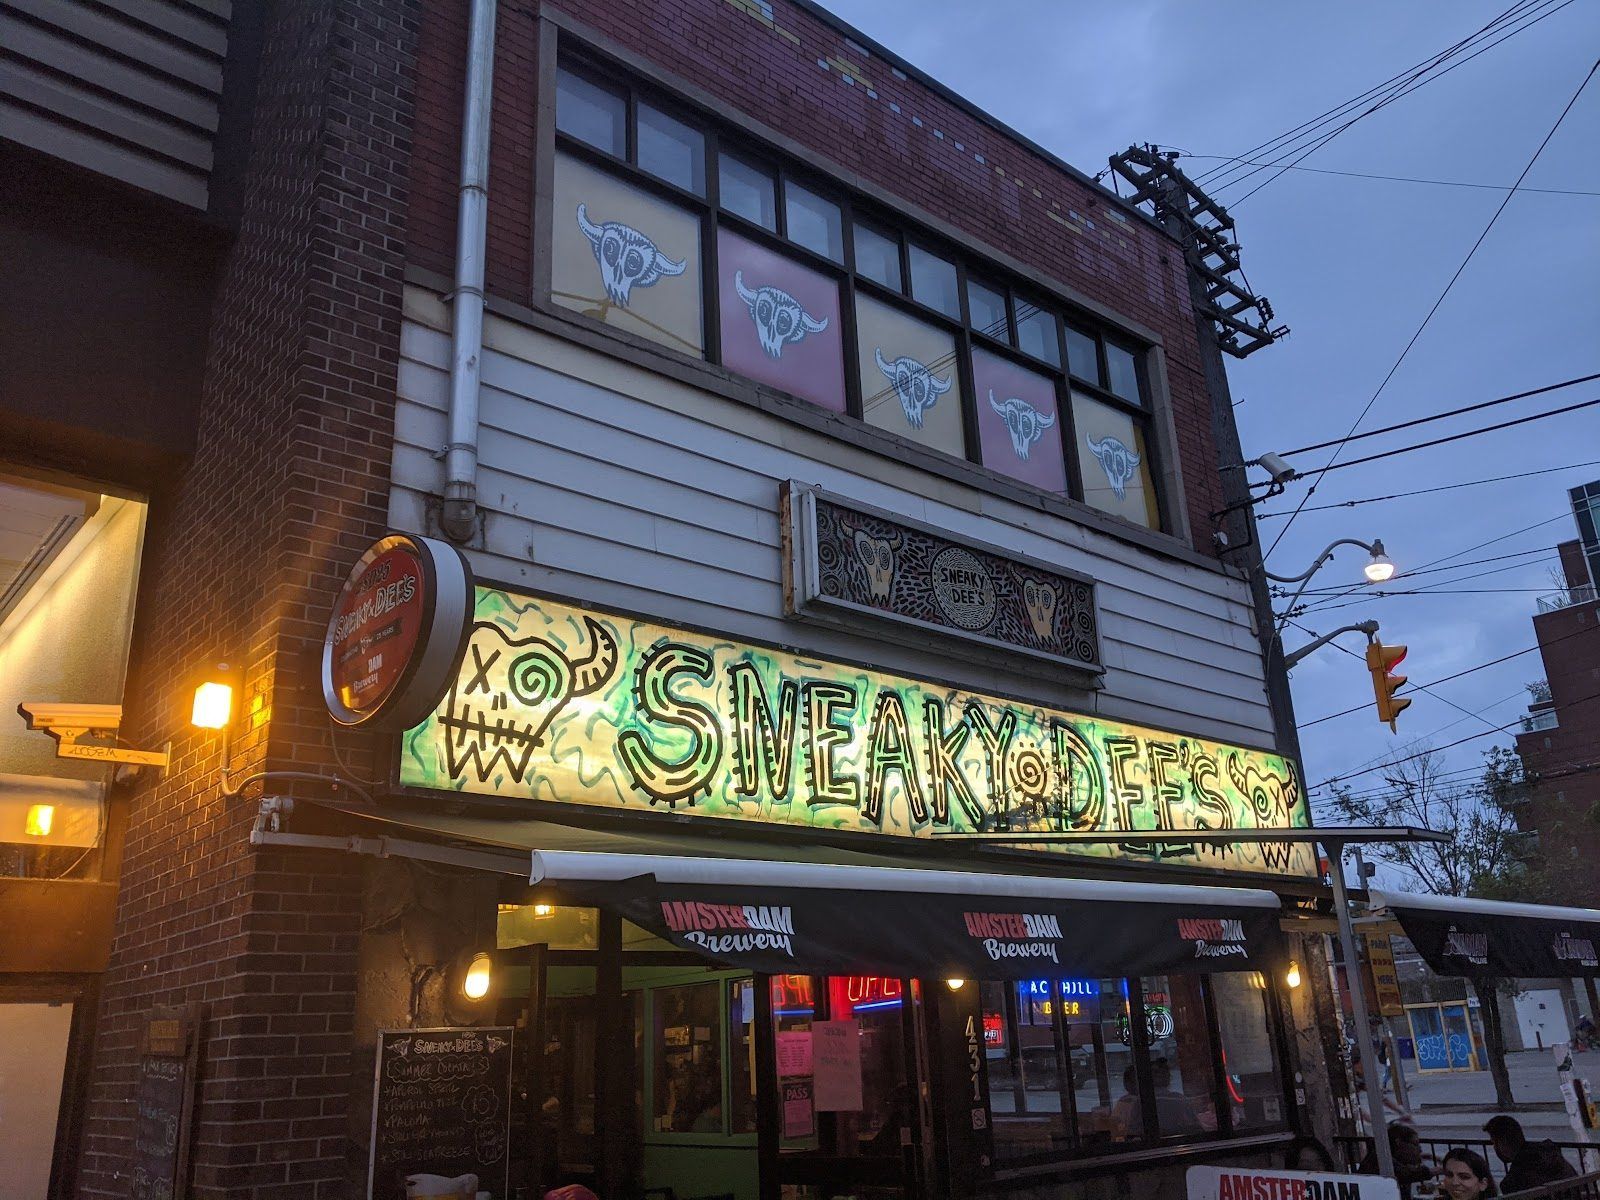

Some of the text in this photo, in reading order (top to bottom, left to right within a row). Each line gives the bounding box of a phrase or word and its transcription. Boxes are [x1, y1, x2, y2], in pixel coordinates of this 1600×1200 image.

[940, 566, 986, 590] SNEAKY
[335, 597, 372, 646] SNEAKY
[374, 573, 416, 619] DEE'S
[951, 588, 986, 607] DEE'S
[617, 641, 1236, 860] SNEAKY DEE'S
[660, 901, 796, 936] AMSTERDAM
[963, 911, 1064, 939] AMSTERDAM
[1177, 919, 1247, 940] AMSTERDAM
[683, 930, 794, 957] Brewery
[983, 938, 1060, 964] Brewery
[1194, 939, 1249, 959] Brewery
[1062, 981, 1093, 995] HILL
[1044, 1001, 1080, 1015] BER
[413, 1038, 484, 1054] SNEAKY DEE'S
[965, 1015, 982, 1101] 431
[786, 1087, 808, 1101] PASS
